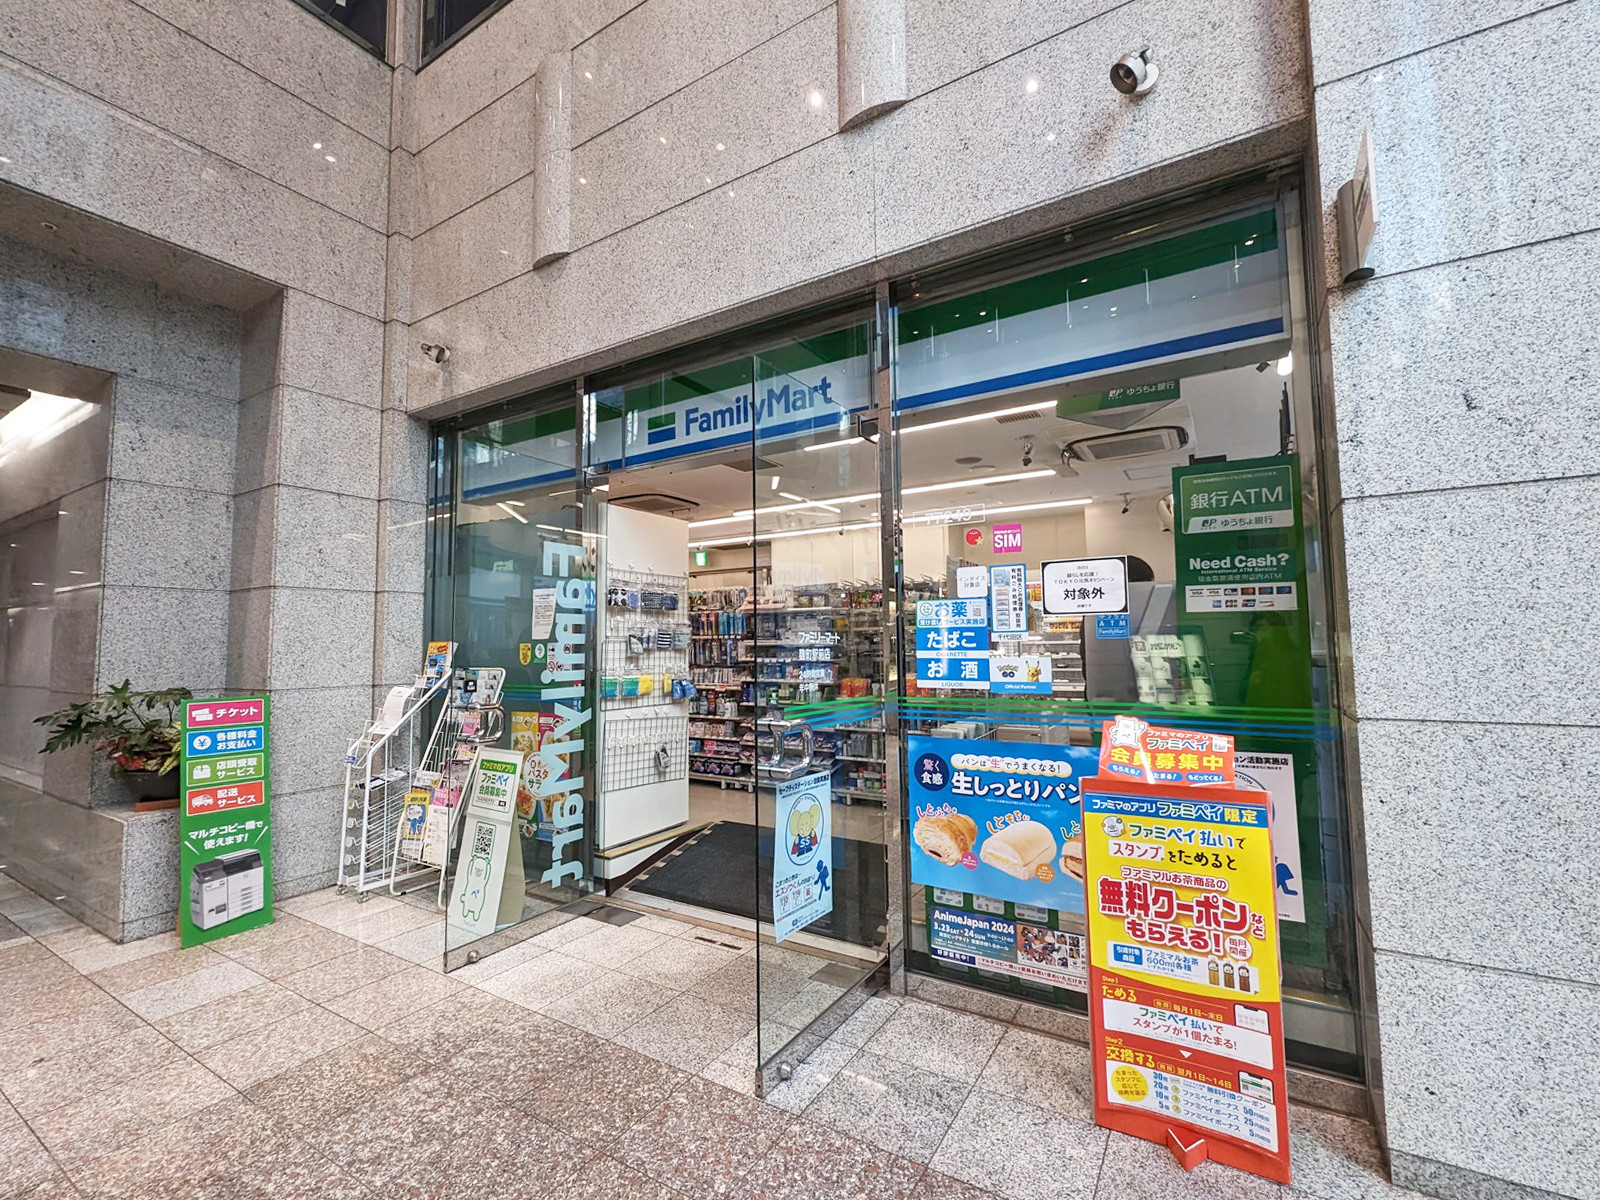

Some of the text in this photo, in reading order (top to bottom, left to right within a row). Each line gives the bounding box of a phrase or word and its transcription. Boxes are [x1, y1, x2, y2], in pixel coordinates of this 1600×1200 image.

[1126, 381, 1175, 397] ゆうちょ銀行
[685, 376, 832, 436] FamilyMart
[1190, 486, 1284, 510] 銀行ATM
[1221, 516, 1274, 527] ゆうちょ銀行
[994, 533, 1021, 548] SIM
[1189, 553, 1290, 570] Need Cash?
[1064, 587, 1106, 600] 対象外
[935, 600, 968, 618] お薬
[798, 632, 840, 644] ファミリーマート
[927, 632, 976, 648] たばこ
[928, 661, 978, 679] お酒
[215, 705, 259, 719] チケット
[216, 730, 257, 741] 各種料金
[1147, 730, 1209, 740] ファミマのアプリ
[216, 740, 256, 751] お支払い
[1147, 738, 1209, 751] ファミペイ
[216, 758, 258, 770] 店頭受取
[923, 759, 940, 772] 驚く
[1110, 747, 1224, 771] 会員募集中
[216, 768, 256, 779] サービス
[481, 772, 510, 787] ファミペイ
[921, 772, 944, 785] 食感
[1112, 765, 1140, 776] もらえる!
[1188, 774, 1223, 783] もどってくる!
[217, 787, 238, 798] 配送
[951, 771, 1080, 804] 生しっとりパン
[217, 795, 257, 808] サービス
[1092, 798, 1258, 824] ファミマのアプリ ファミペイ限定
[188, 820, 264, 840] マルチコピー機で
[1128, 823, 1246, 850] ファミペイ払いで
[204, 833, 249, 850] 使えます!
[1121, 867, 1227, 890] ファミマルお茶商品の
[1099, 877, 1249, 933] 無料クーポン
[933, 909, 1015, 935] AnimeJapan 2024
[1126, 919, 1223, 954] もらえる!
[1229, 937, 1247, 948] 毎月
[1146, 949, 1199, 966] ファミマルお茶
[1229, 947, 1249, 957] 開催
[1146, 957, 1192, 972] 600ml各種
[1102, 984, 1137, 1002] ためる
[1139, 1007, 1223, 1034] ファミペイ払いで
[1133, 1018, 1237, 1050] スタンプが1個たまる!
[1106, 1046, 1155, 1068] 交換する
[1182, 1089, 1240, 1112] ファミペイボーナス
[1183, 1099, 1241, 1122] ファミペイボーナス
[1183, 1109, 1241, 1132] ファミペイボーナス
